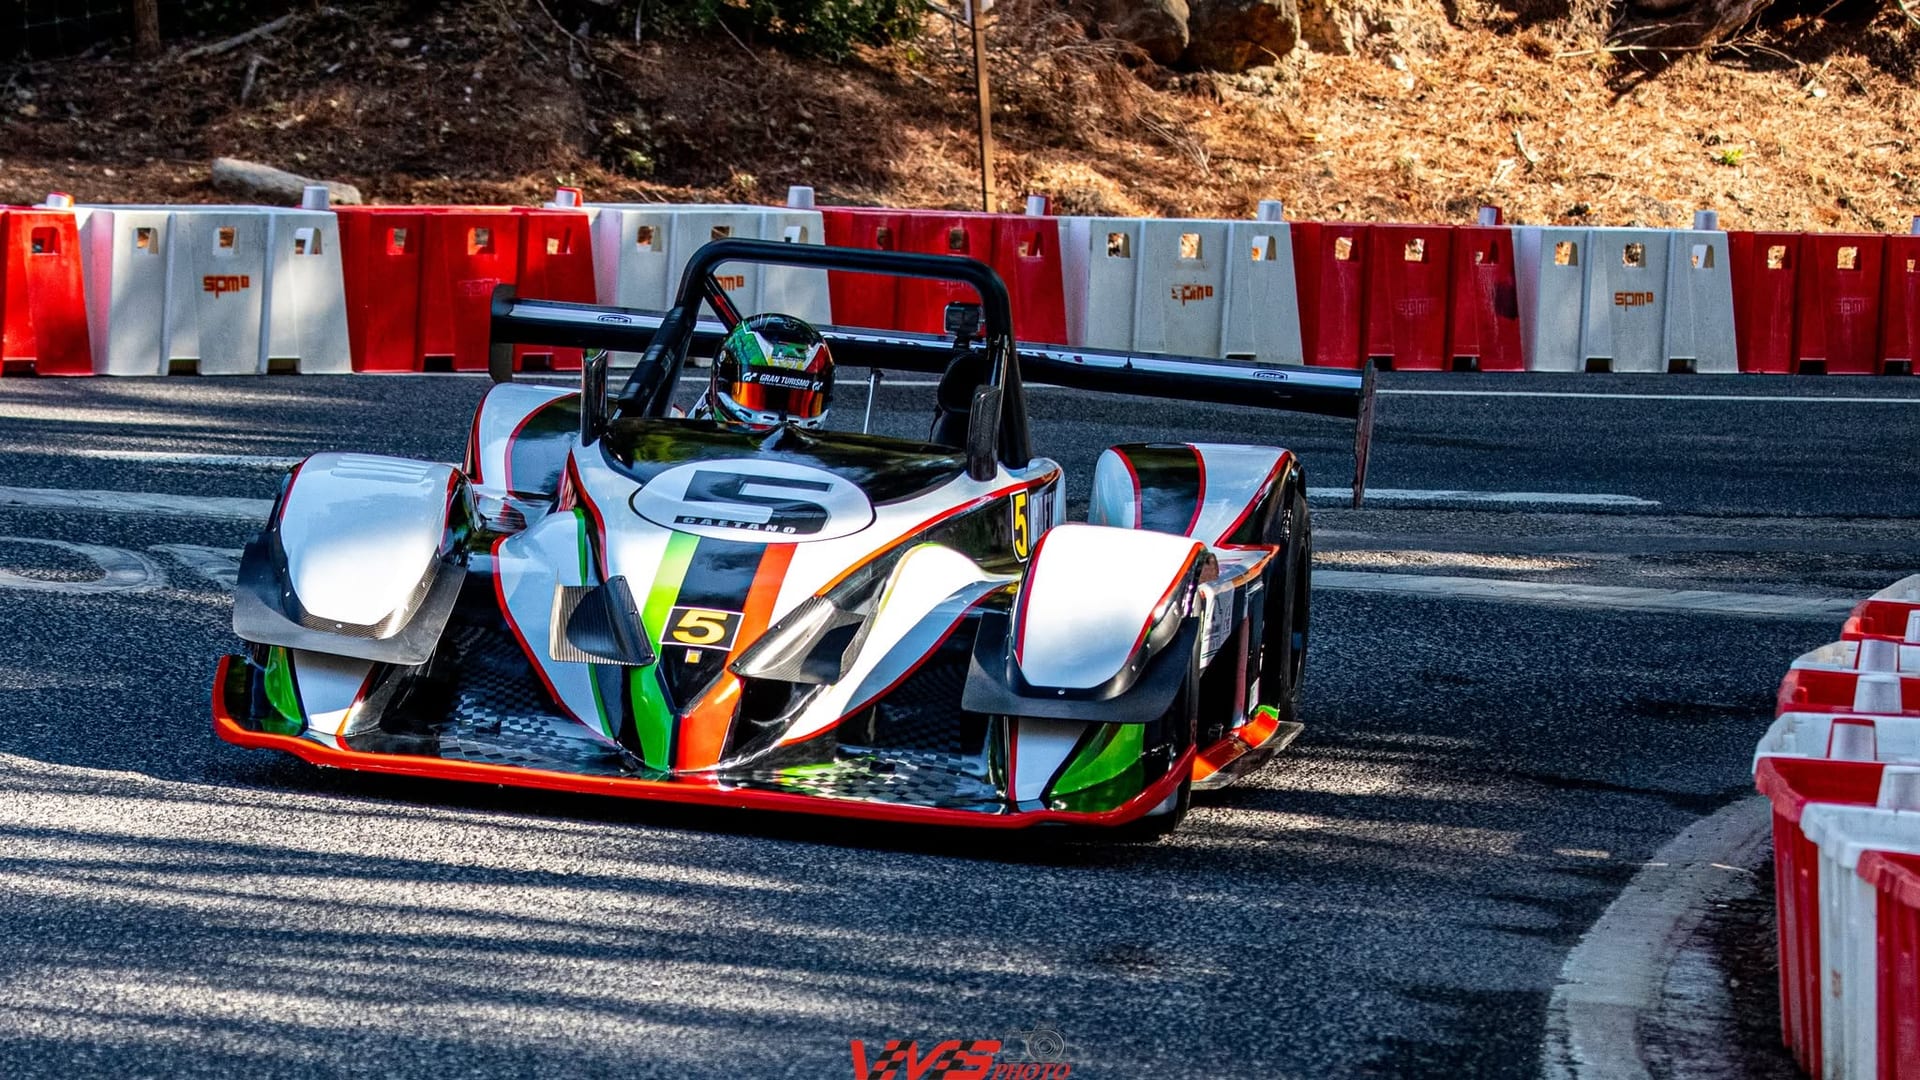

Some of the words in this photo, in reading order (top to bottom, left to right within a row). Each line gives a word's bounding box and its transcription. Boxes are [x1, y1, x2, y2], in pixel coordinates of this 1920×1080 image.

[759, 374, 781, 383] GRAN
[781, 376, 810, 388] TURISMO
[674, 470, 834, 535] 5
[682, 516, 797, 534] CAETANO
[1014, 493, 1028, 558] 5
[672, 609, 729, 646] 5
